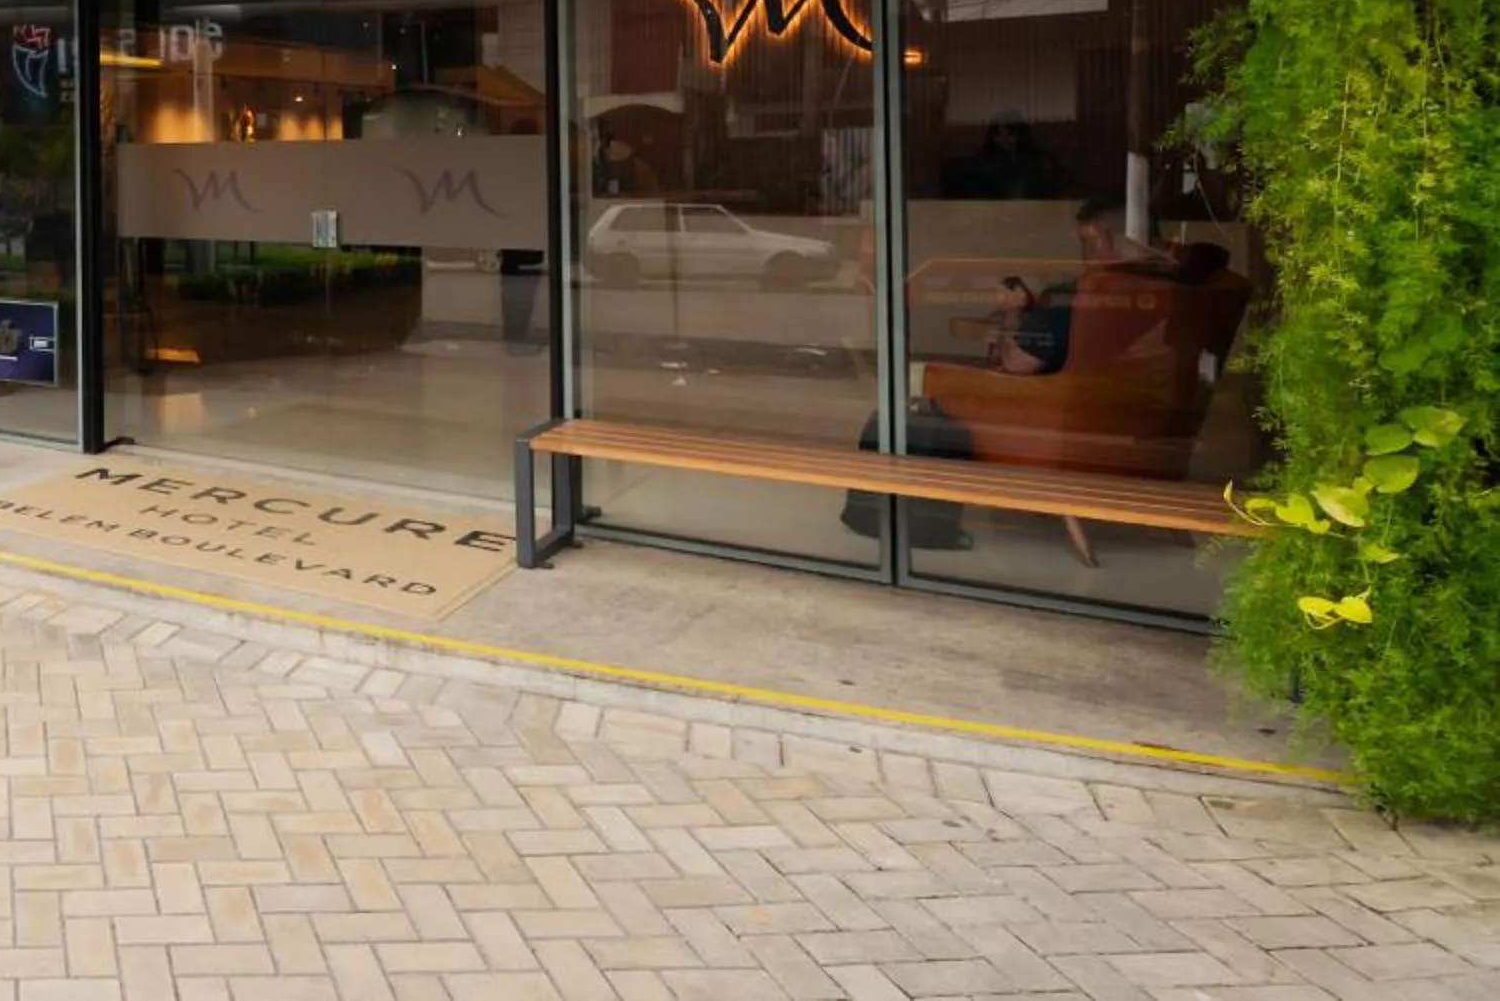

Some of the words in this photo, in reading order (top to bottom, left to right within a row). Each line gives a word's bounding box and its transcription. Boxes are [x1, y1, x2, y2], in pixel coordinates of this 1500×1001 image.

[74, 467, 516, 552] MERCURE
[138, 504, 316, 546] HOTEL
[127, 528, 437, 596] BOULEVARD
